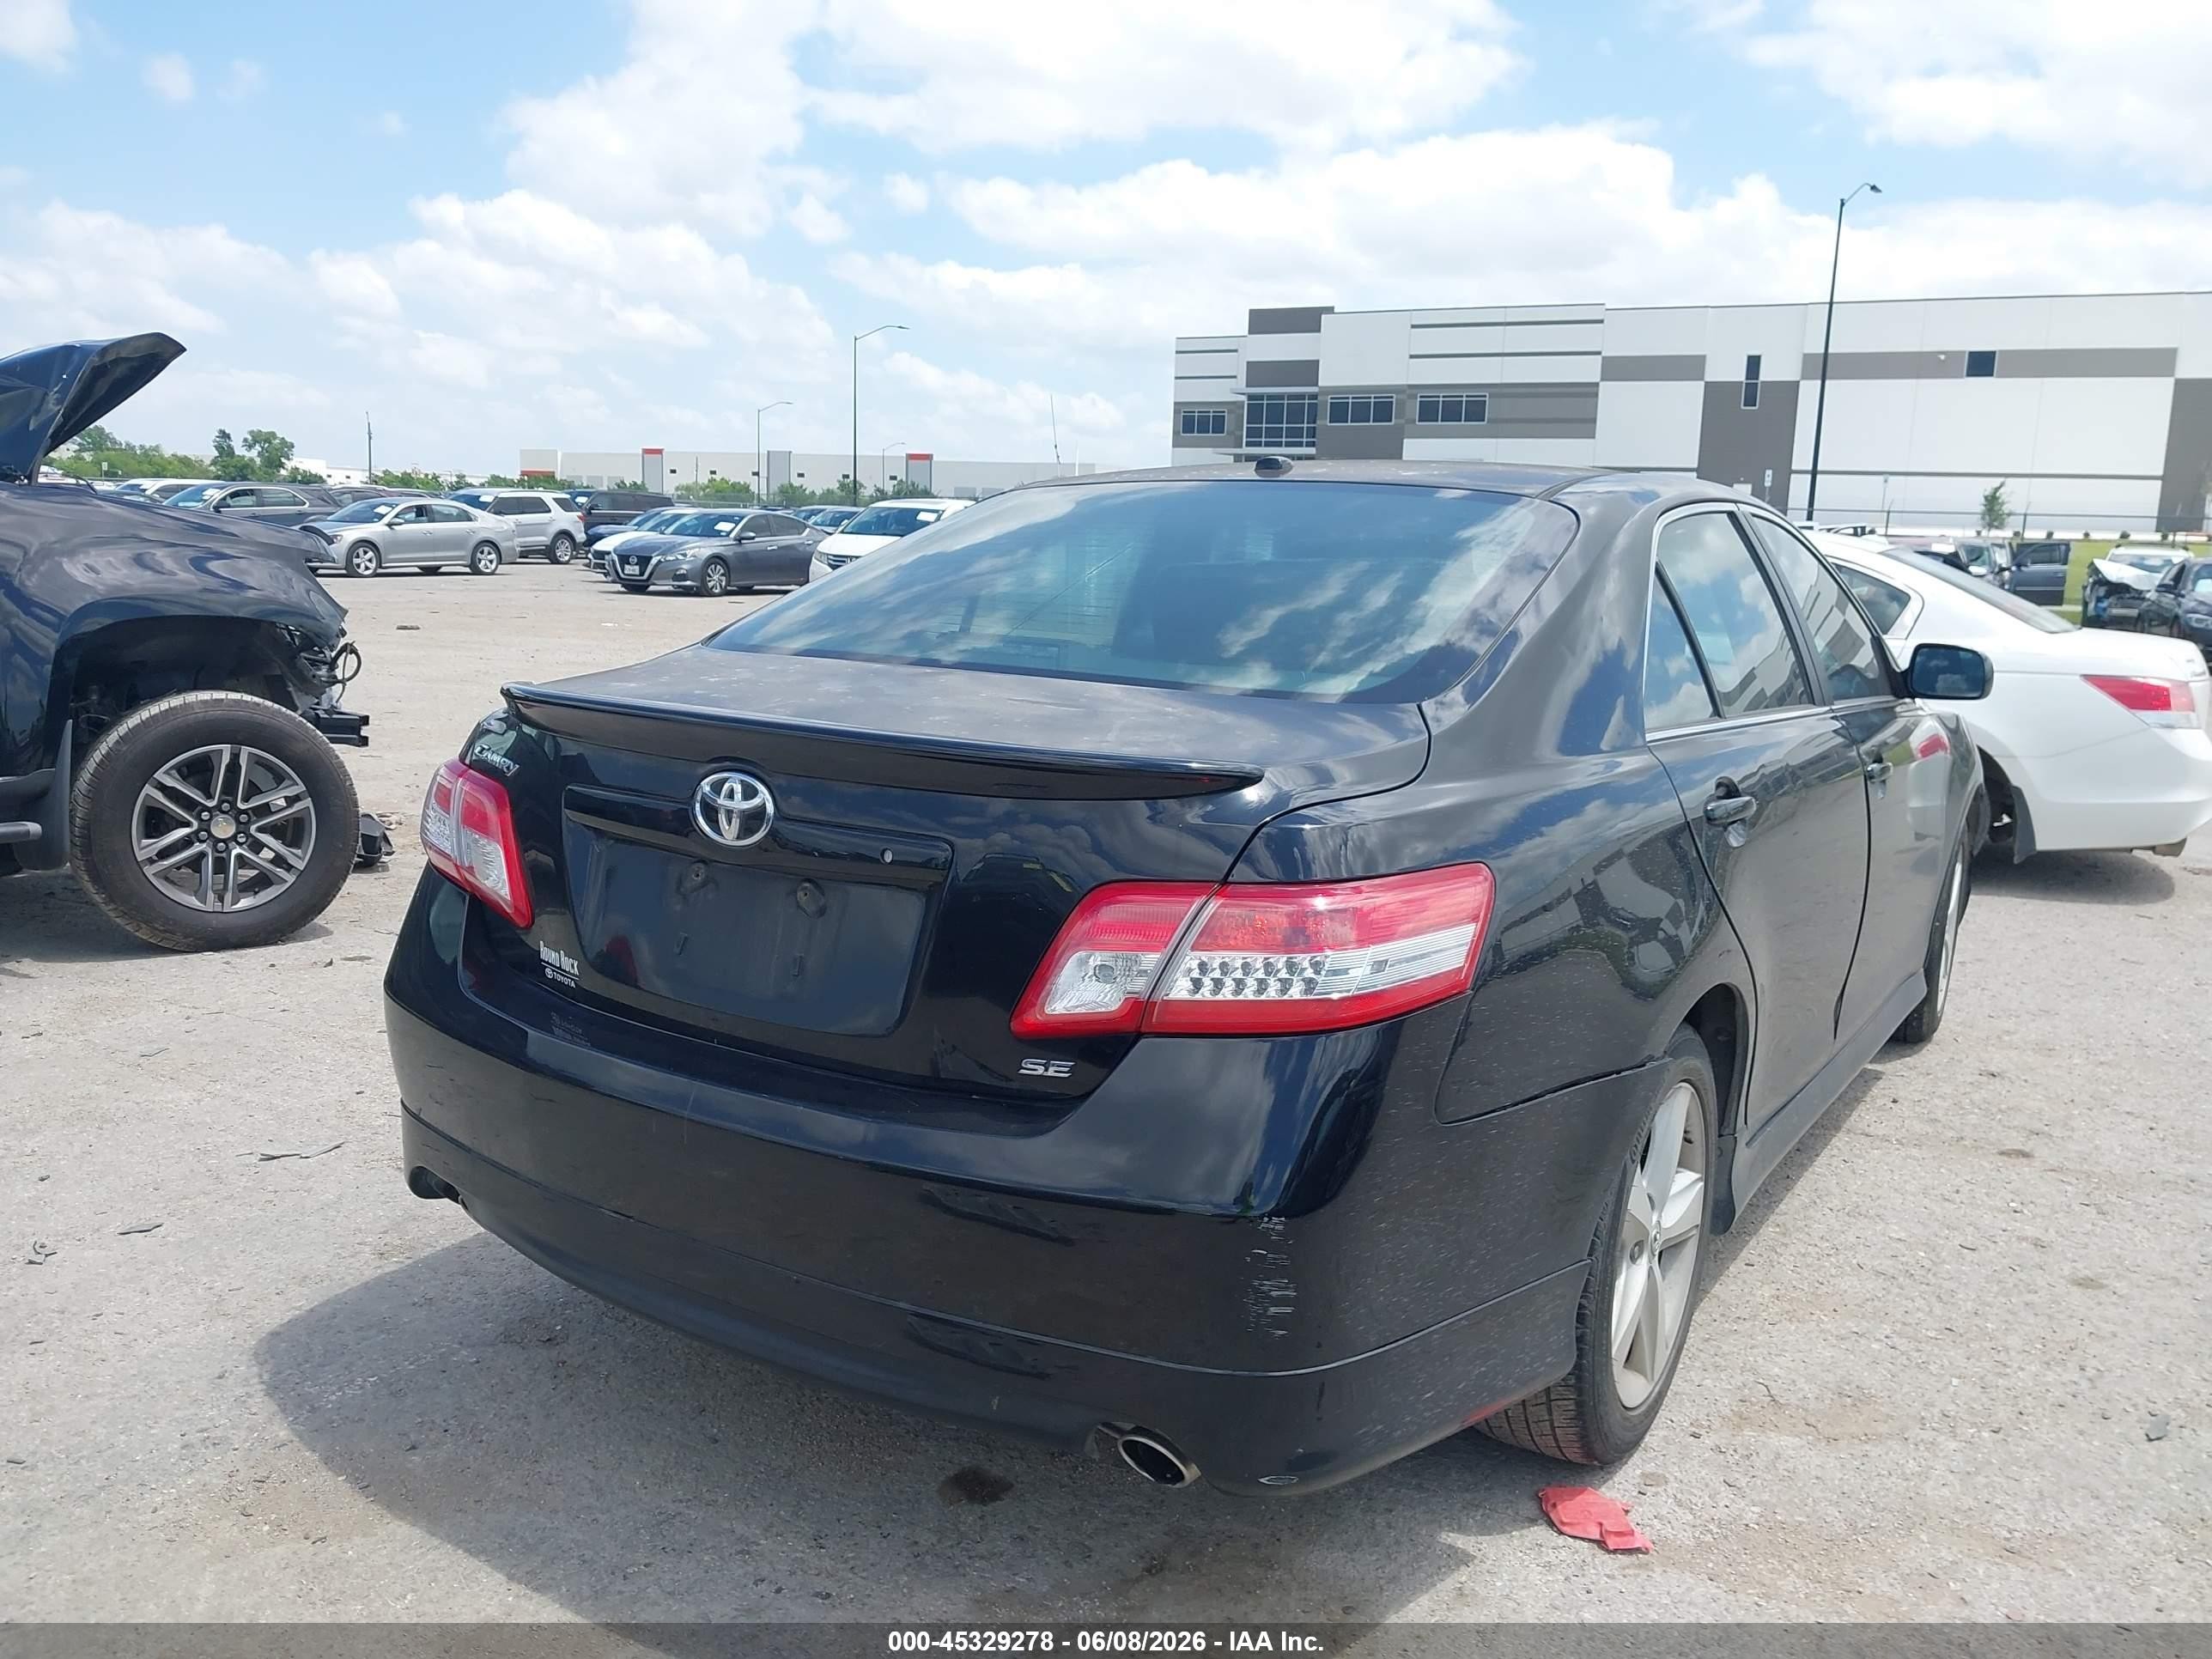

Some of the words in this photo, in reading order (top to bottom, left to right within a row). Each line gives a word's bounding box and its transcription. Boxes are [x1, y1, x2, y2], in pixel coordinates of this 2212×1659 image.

[560, 950, 580, 976] ROCK
[553, 971, 576, 988] TOYOTA
[1017, 1058, 1076, 1078] SE
